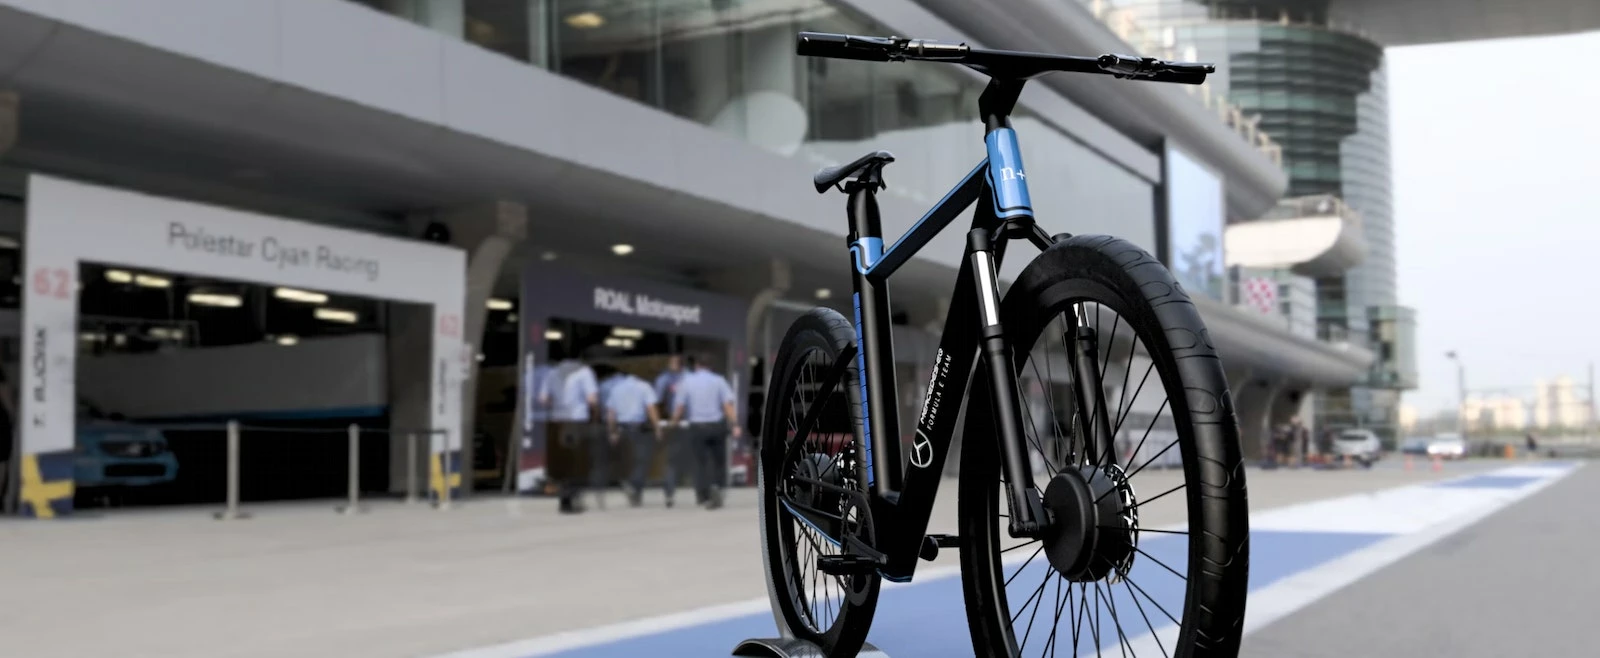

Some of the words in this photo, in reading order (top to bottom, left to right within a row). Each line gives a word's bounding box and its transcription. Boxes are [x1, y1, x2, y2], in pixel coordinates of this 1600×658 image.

[167, 221, 254, 258] Polestar
[261, 236, 310, 270] Cyan
[315, 245, 380, 281] Racing
[33, 268, 71, 299] 62
[636, 294, 701, 327] Motorsport
[926, 391, 942, 430] FORMULA
[941, 354, 952, 378] TEAM
